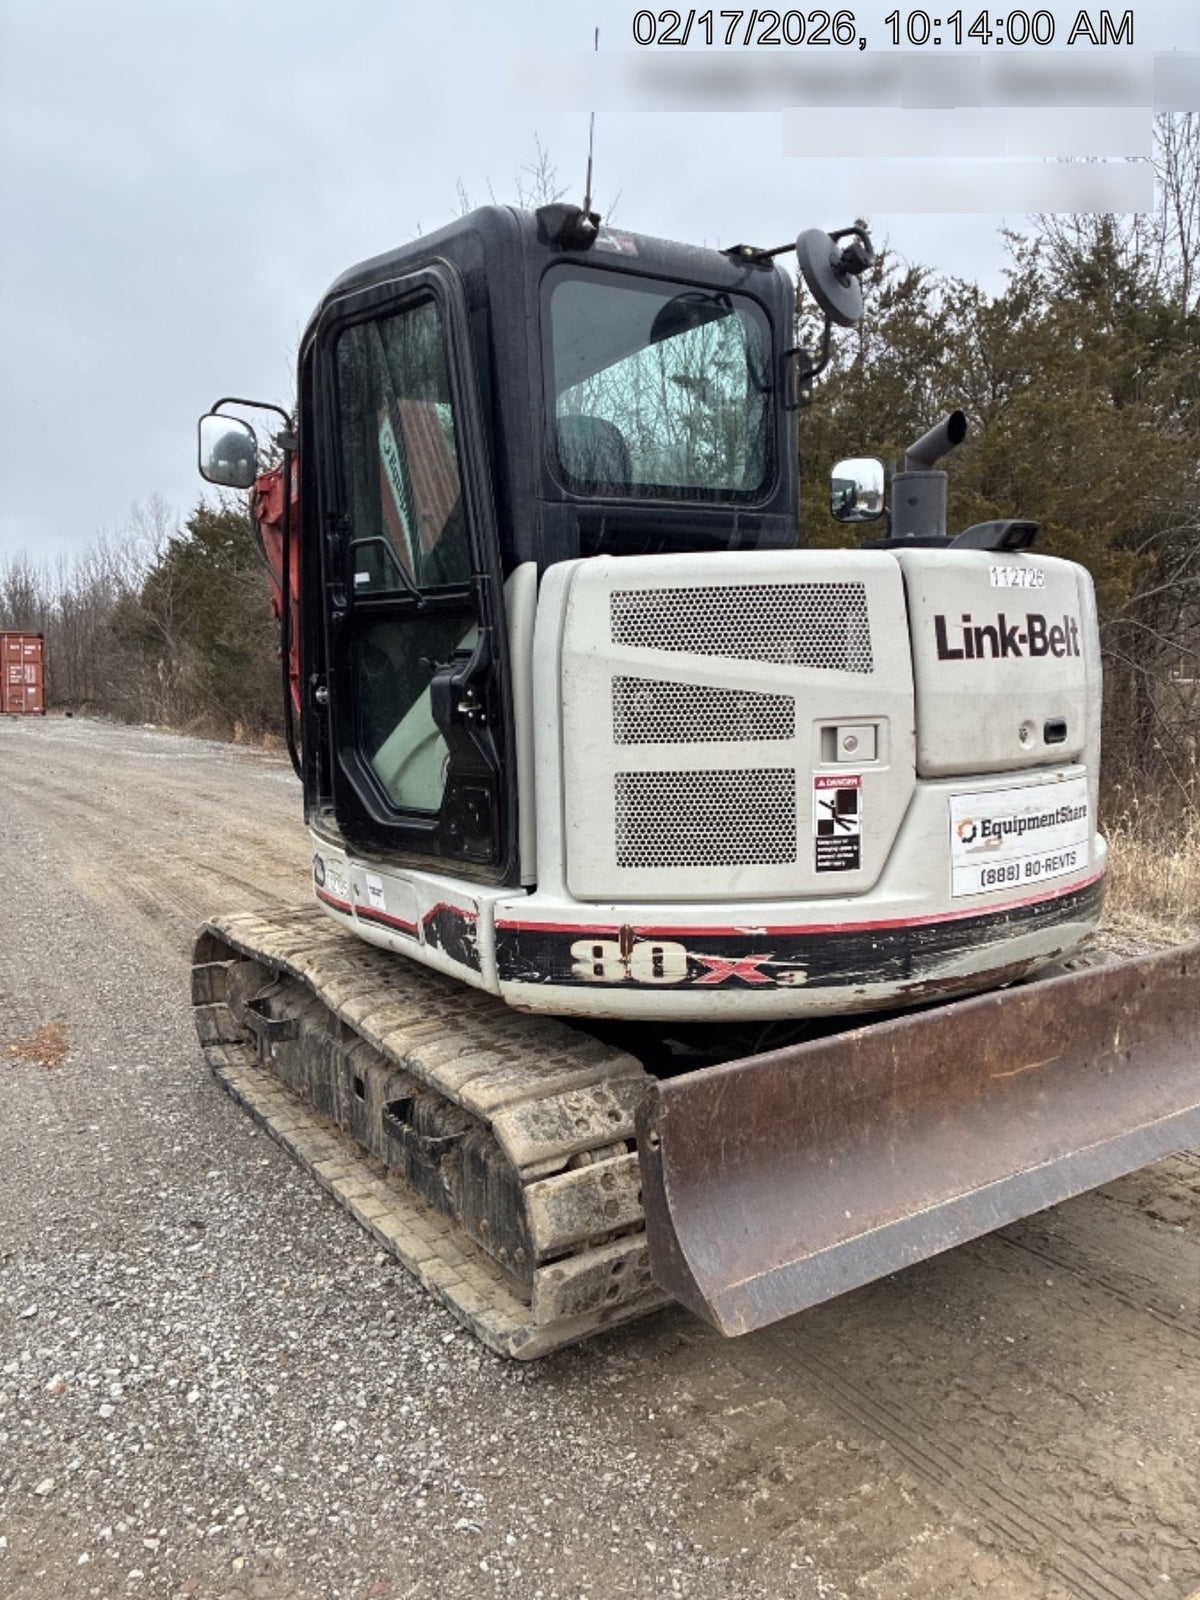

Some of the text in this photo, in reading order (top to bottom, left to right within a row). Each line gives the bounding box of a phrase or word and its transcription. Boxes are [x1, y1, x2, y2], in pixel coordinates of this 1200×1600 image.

[991, 567, 1045, 588] 112726
[934, 613, 1080, 660] Link-Belt
[980, 804, 1088, 840] EquipmentShare
[1025, 851, 1078, 878] 80-RENTS
